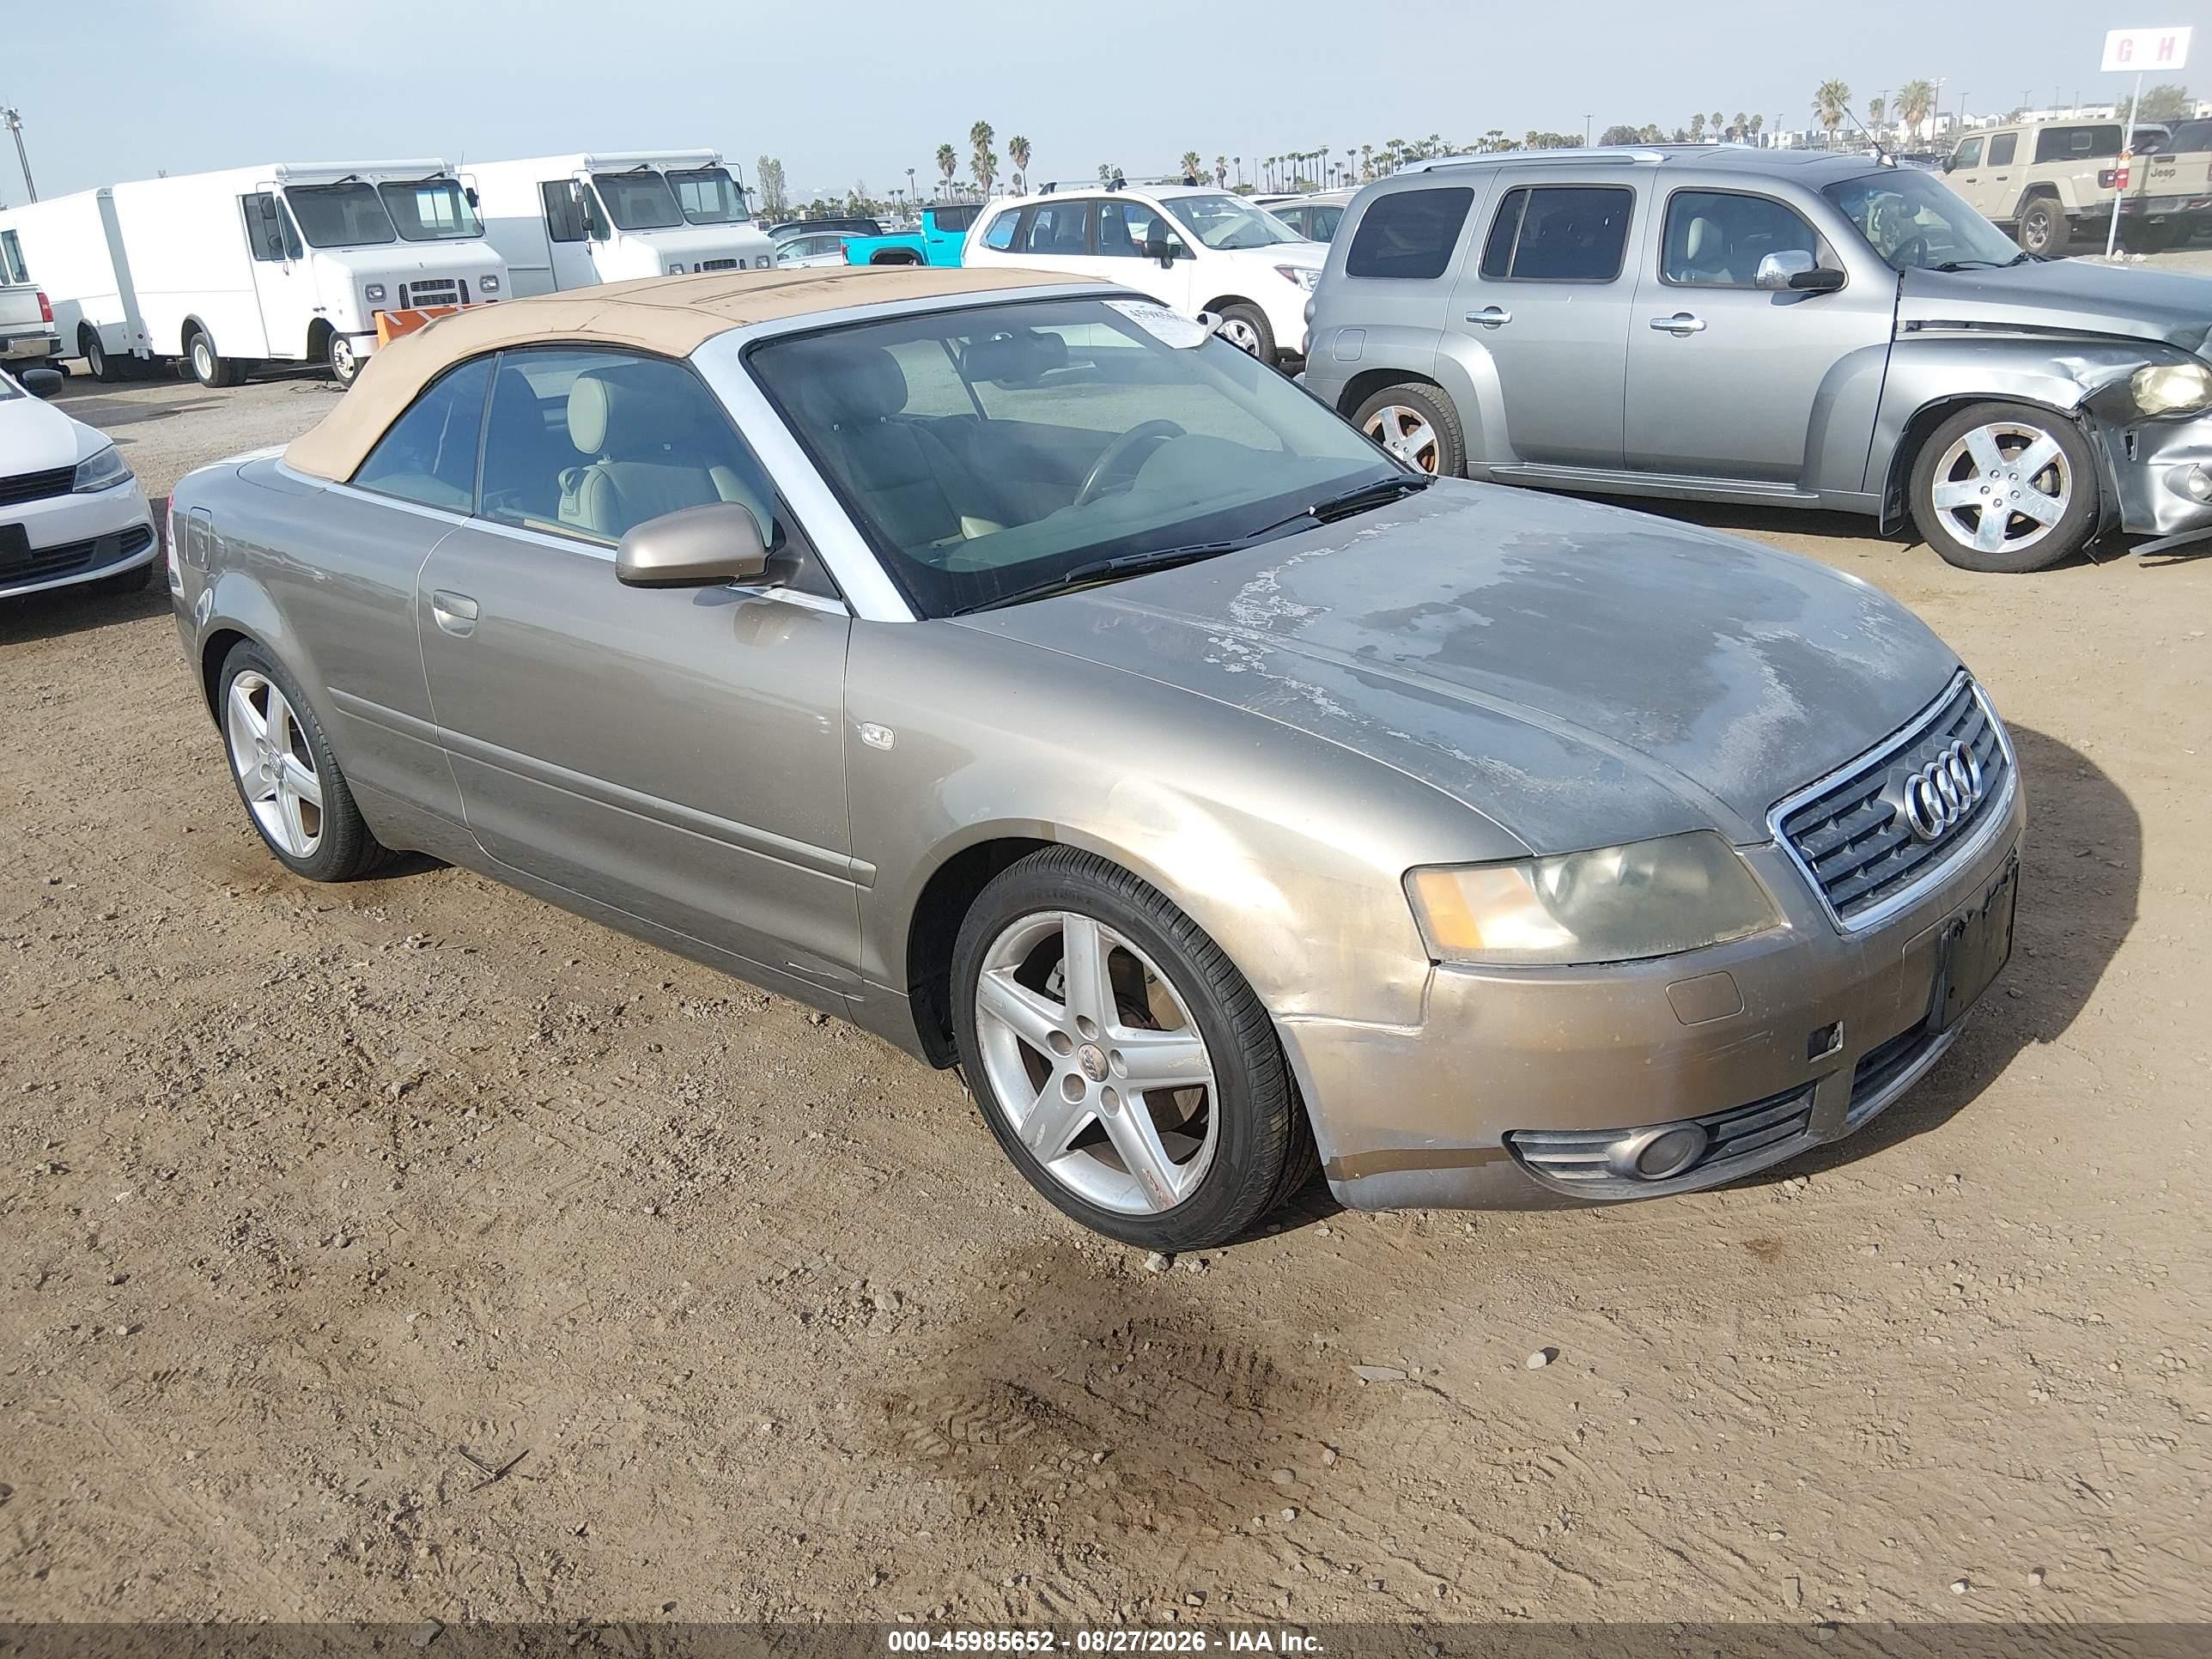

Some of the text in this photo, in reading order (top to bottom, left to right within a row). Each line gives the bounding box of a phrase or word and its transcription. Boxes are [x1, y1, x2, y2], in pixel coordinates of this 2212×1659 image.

[2117, 37, 2175, 62] G H
[2150, 168, 2176, 179] Jeep
